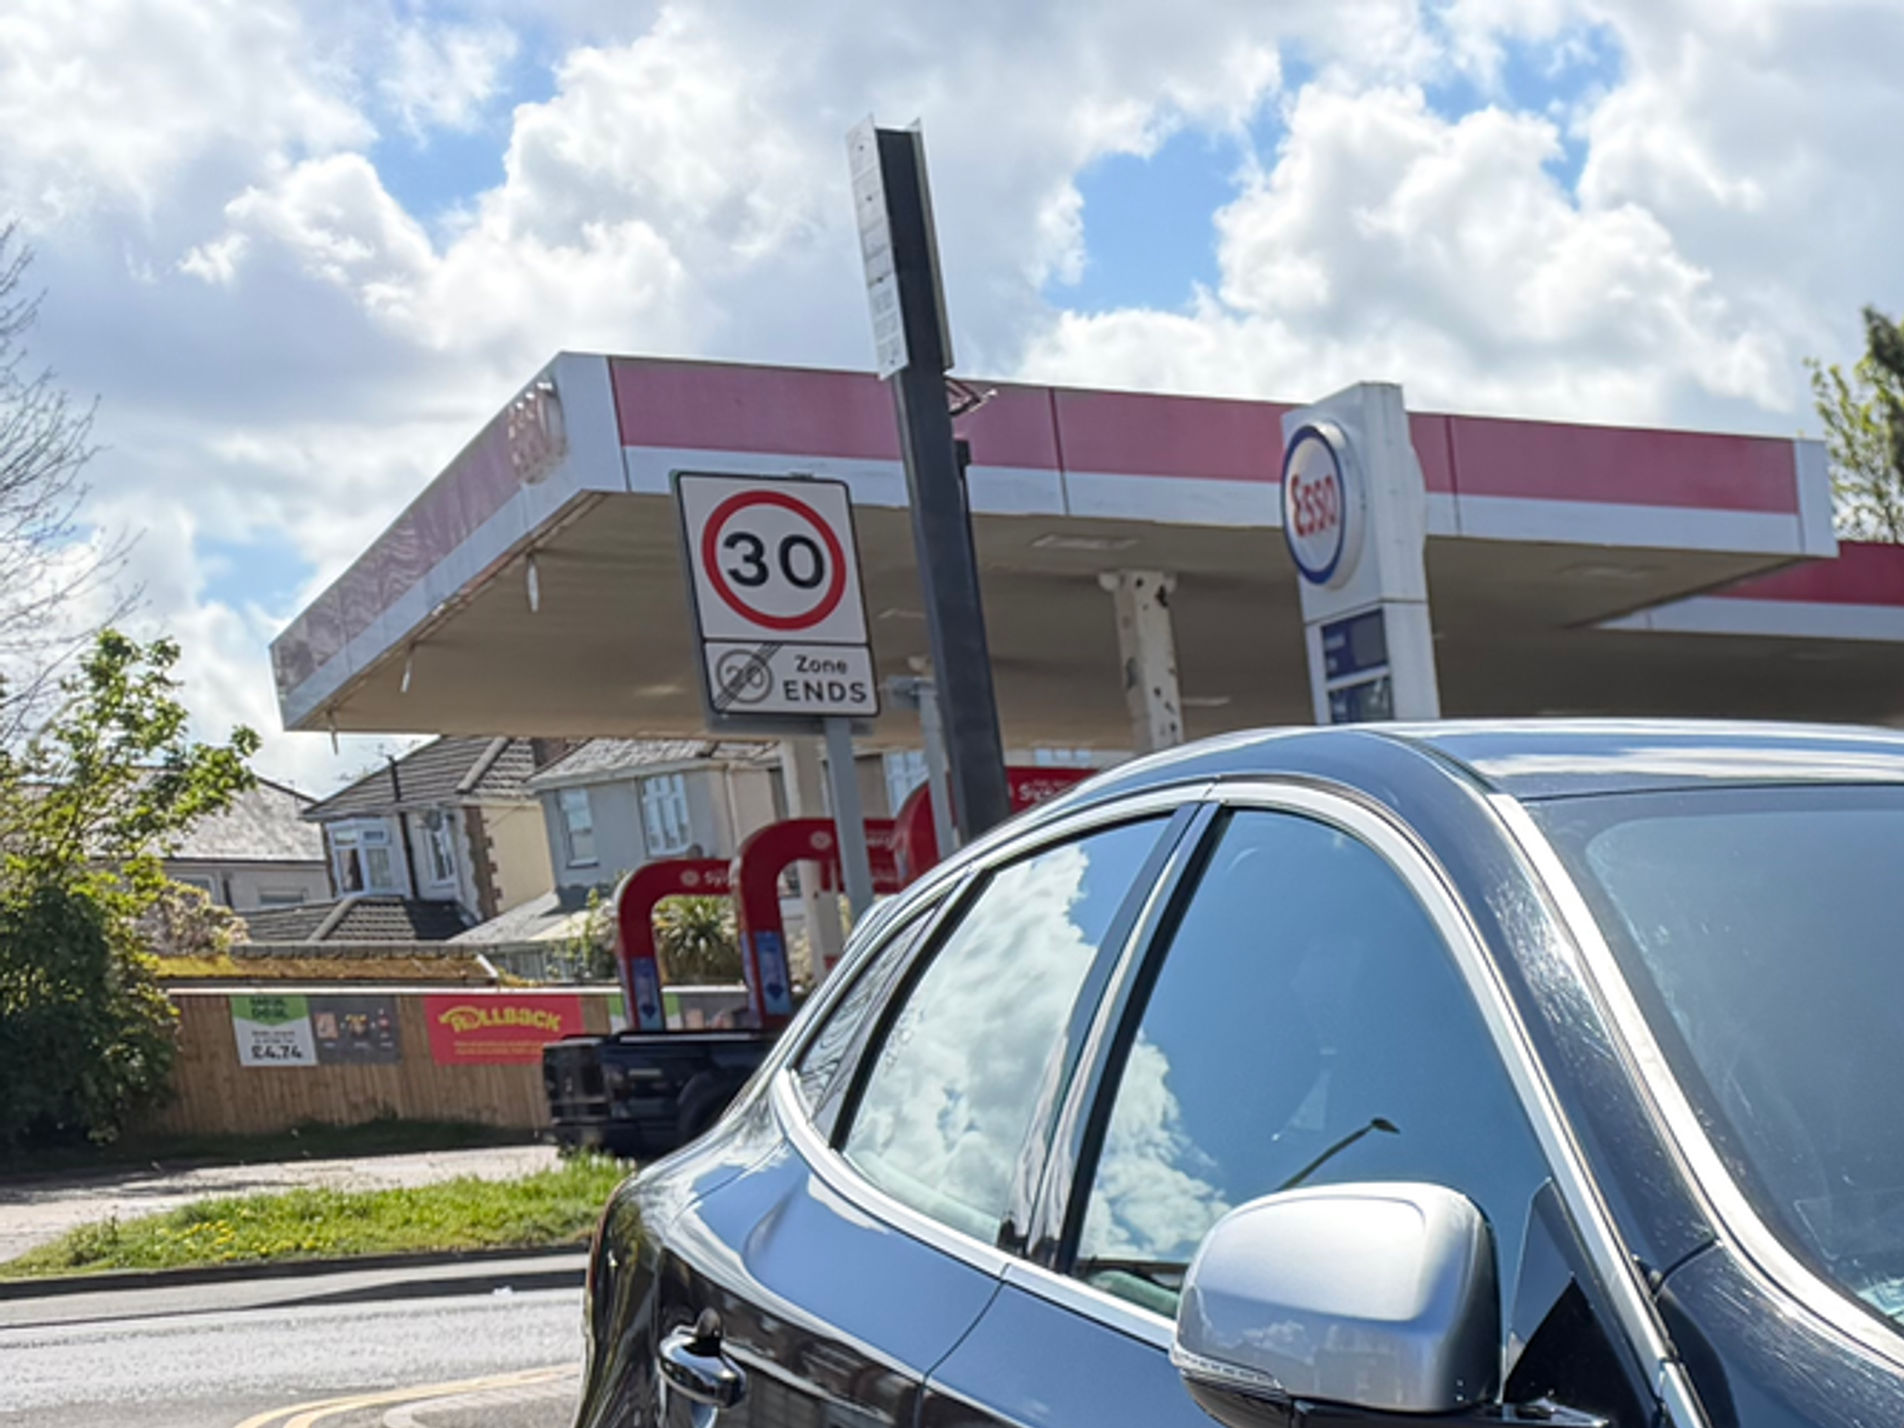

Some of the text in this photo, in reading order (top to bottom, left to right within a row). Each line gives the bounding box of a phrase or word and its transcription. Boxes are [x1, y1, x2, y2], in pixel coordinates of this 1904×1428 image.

[722, 531, 825, 589] 30
[795, 654, 848, 675] Zone
[783, 680, 868, 704] ENDS
